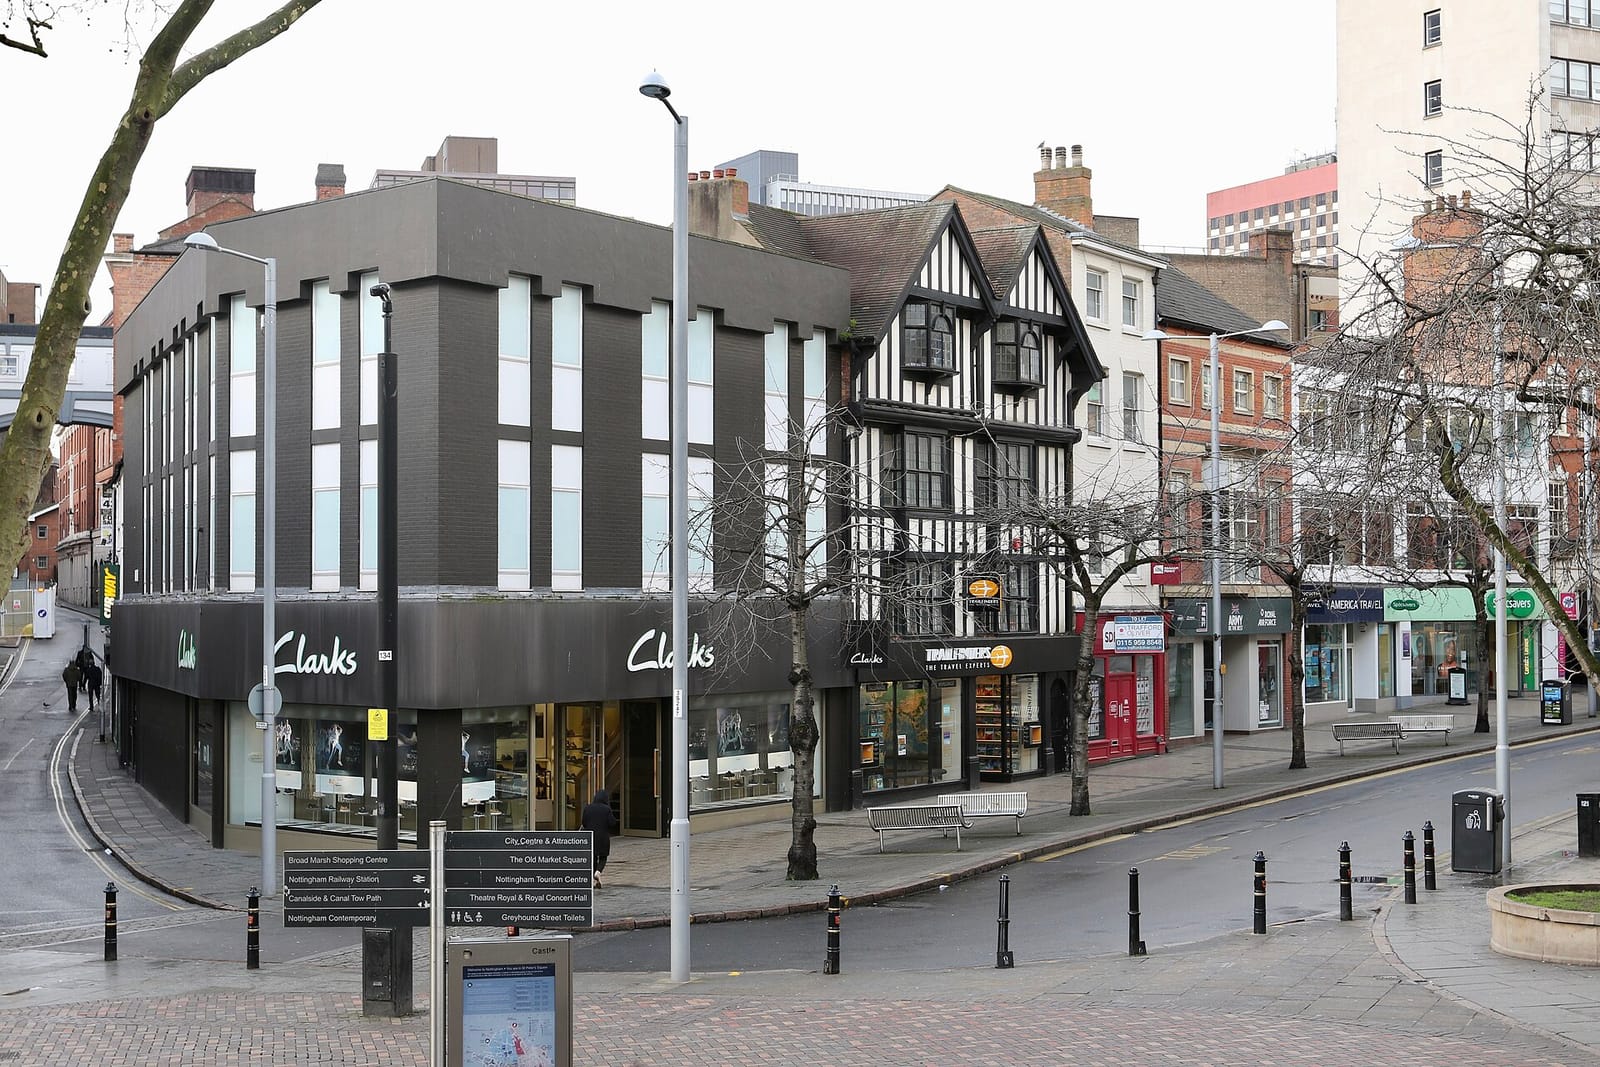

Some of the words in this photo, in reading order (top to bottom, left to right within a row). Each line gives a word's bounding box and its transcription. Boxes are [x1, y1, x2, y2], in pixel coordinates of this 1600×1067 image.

[1330, 600, 1358, 609] AMERICA
[1360, 600, 1383, 609] TRAVEL
[1228, 615, 1243, 625] ARMY
[1105, 632, 1115, 642] SD
[178, 629, 196, 670] Clarks
[274, 630, 357, 675] Clarks
[627, 629, 715, 672] Claks
[851, 652, 883, 664] Clarks
[926, 647, 991, 662] TRAILFINDERS
[332, 856, 364, 865] Shopping
[562, 856, 587, 864] Square
[288, 876, 327, 885] Nottingham
[328, 876, 355, 884] Railway
[495, 876, 534, 884] Nottingham
[497, 894, 516, 902] Royal
[525, 894, 544, 902] Royal
[288, 915, 326, 923] Nottingham
